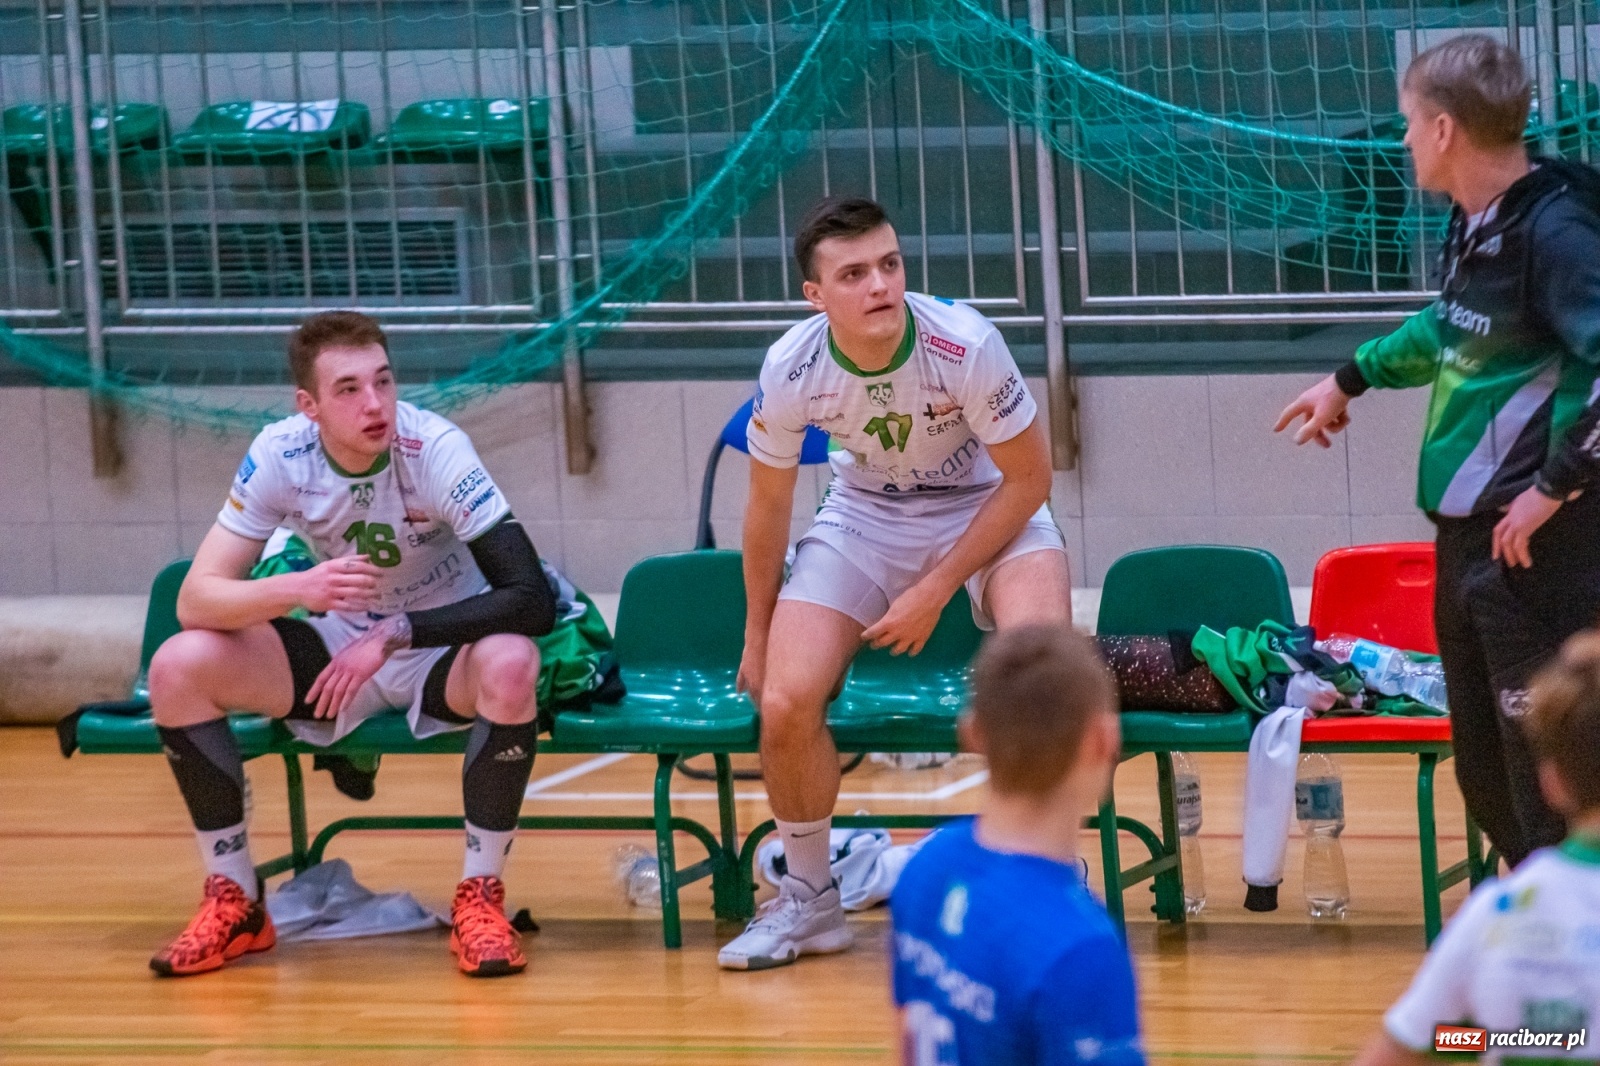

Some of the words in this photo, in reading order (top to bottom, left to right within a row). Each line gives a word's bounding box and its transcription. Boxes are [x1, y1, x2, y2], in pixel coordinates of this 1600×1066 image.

[931, 336, 965, 356] OMEGA
[998, 387, 1026, 419] UNIMOT
[863, 411, 913, 453] 17
[343, 520, 402, 568] 16
